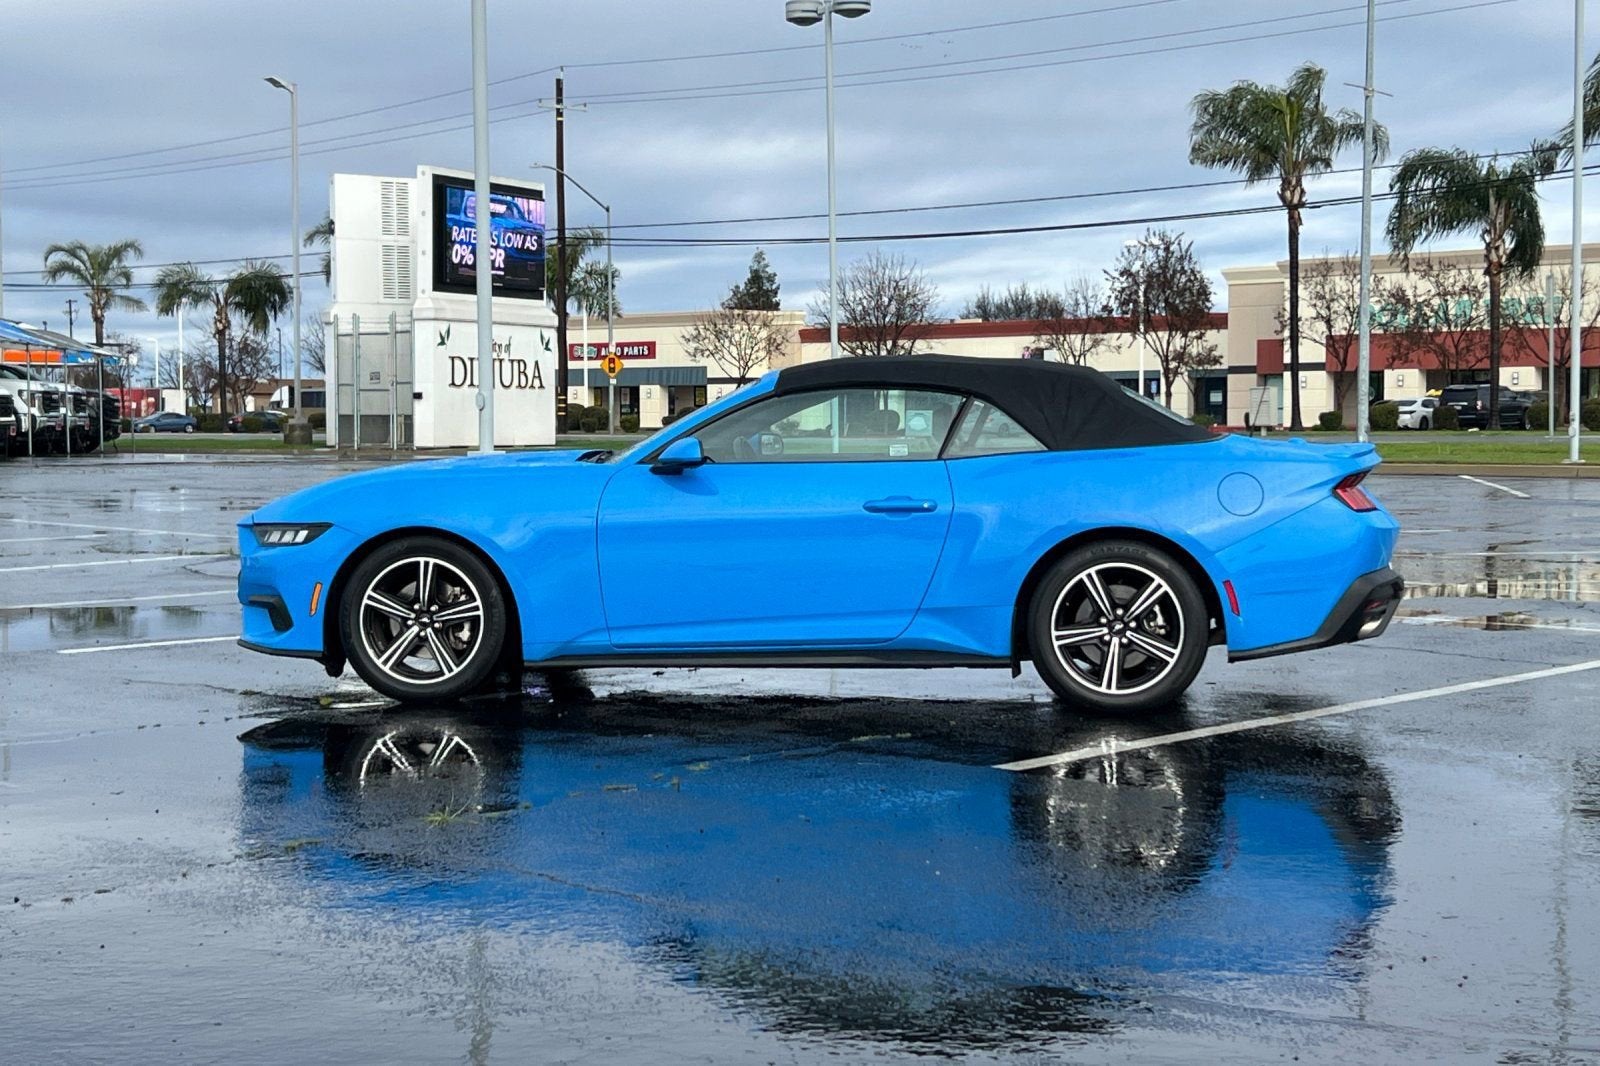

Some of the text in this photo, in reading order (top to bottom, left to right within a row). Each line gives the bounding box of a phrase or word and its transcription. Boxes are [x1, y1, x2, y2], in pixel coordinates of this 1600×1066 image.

[452, 226, 477, 243] RATE
[501, 231, 524, 249] LOW
[524, 234, 538, 251] AS
[452, 244, 474, 265] 0%
[504, 336, 513, 358] of
[601, 346, 622, 356] AO
[623, 345, 649, 356] PARTS
[448, 356, 545, 389] DIUBA
